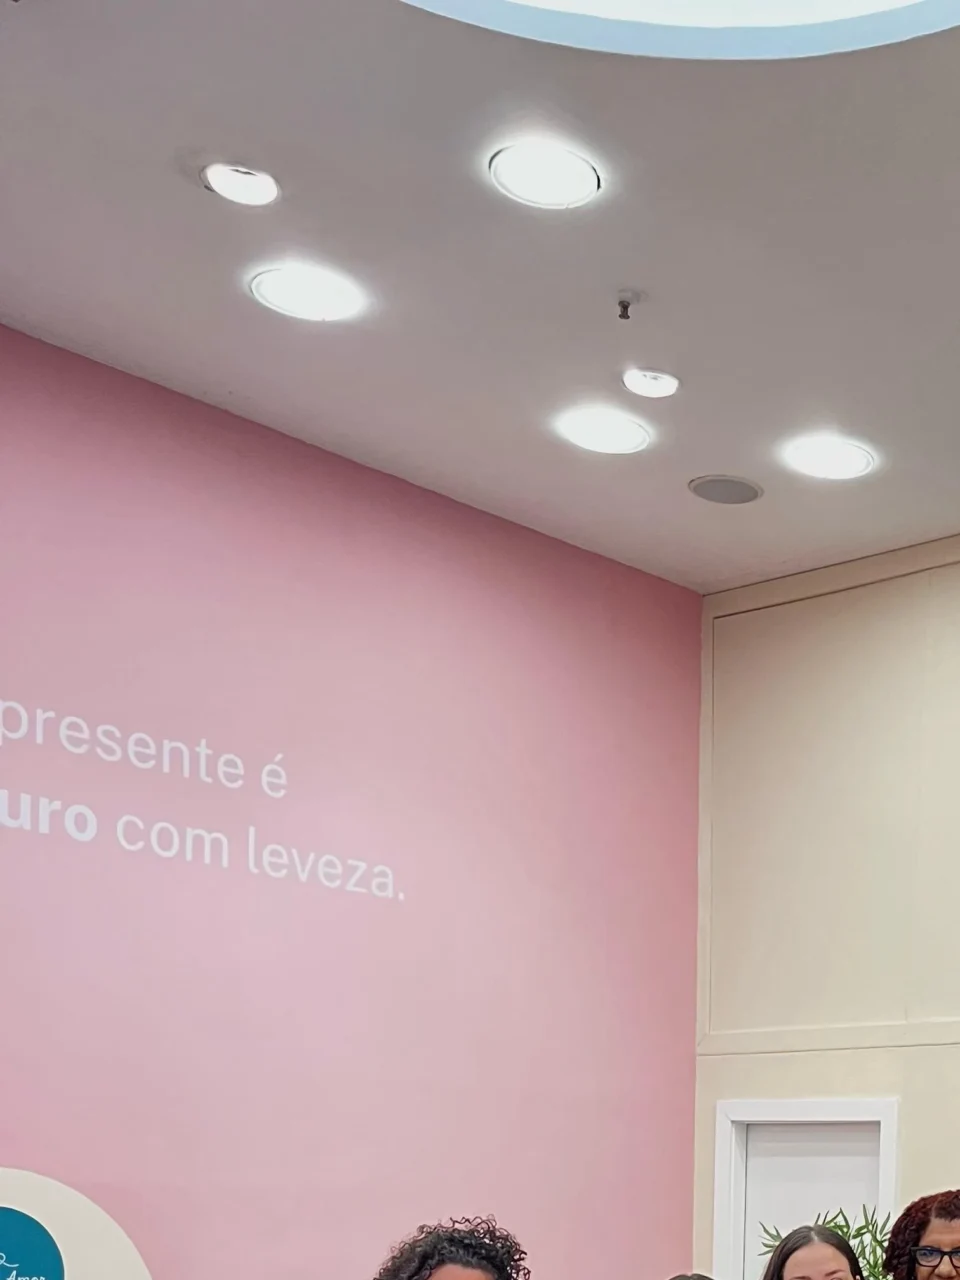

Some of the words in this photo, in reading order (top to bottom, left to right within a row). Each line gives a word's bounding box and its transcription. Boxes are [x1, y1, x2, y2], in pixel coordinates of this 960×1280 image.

[0, 700, 245, 789] presente
[260, 753, 288, 798] é
[116, 814, 229, 868] com
[247, 826, 405, 900] leveza.
